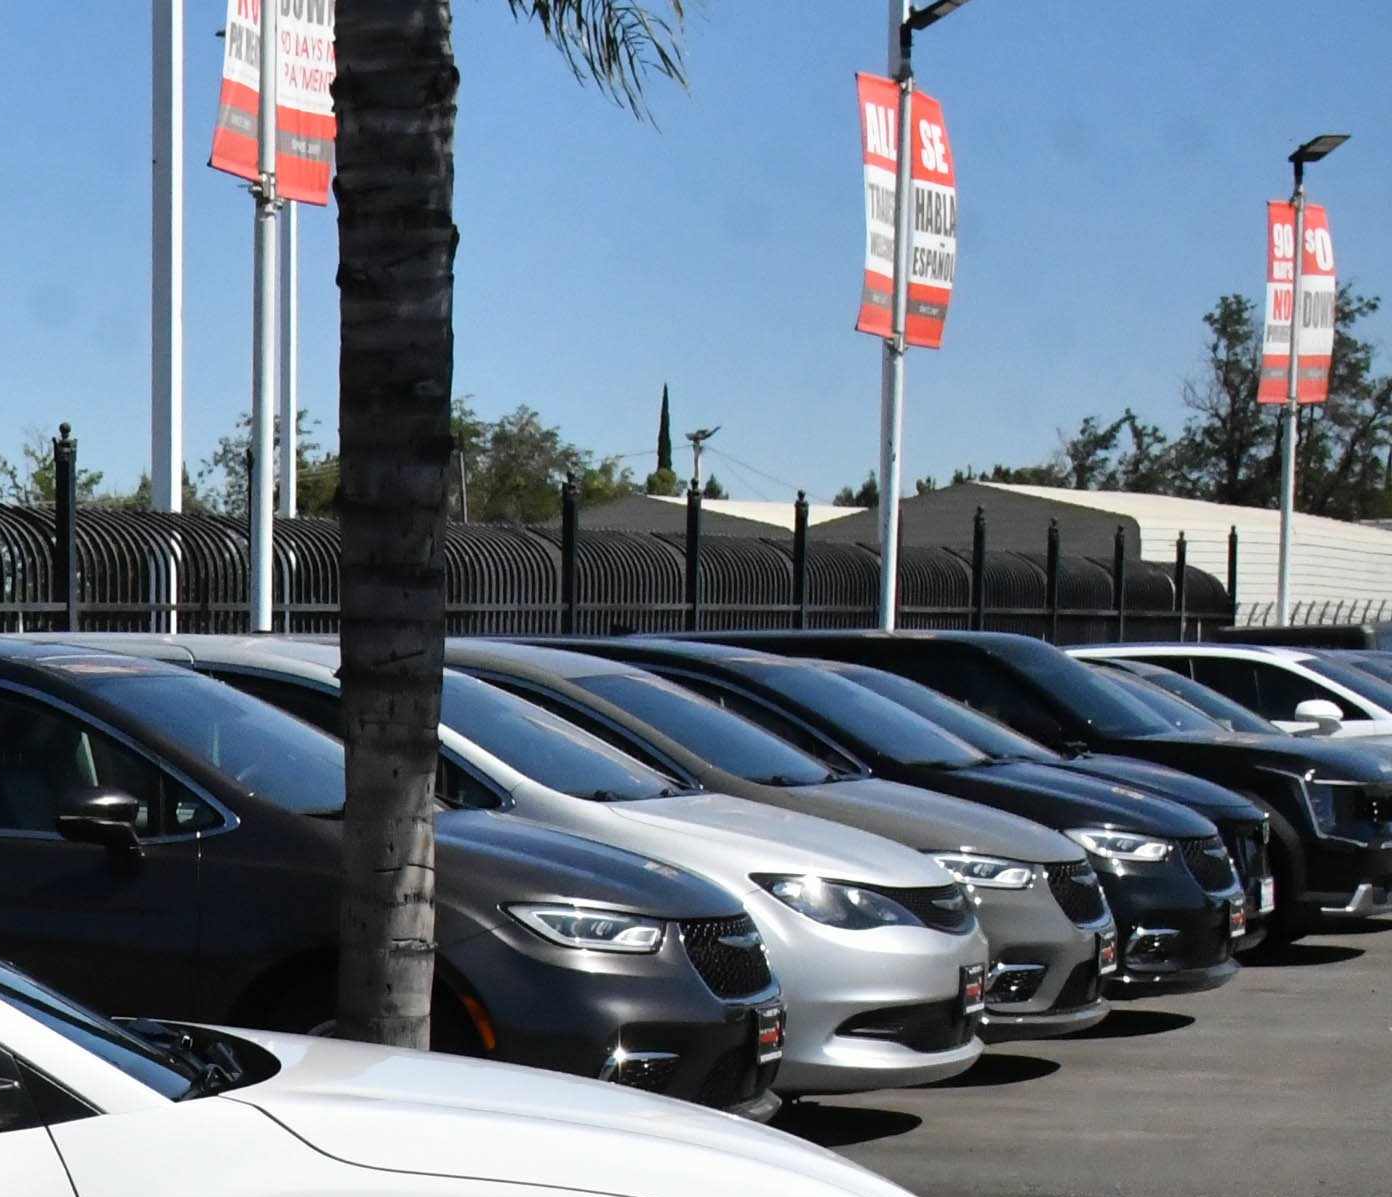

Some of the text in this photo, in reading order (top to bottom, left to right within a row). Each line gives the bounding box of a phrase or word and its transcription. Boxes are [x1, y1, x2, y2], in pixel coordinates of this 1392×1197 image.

[284, 62, 336, 94] AMENT
[865, 102, 897, 161] ALL
[919, 119, 948, 174] SE
[916, 188, 956, 237] HABLA
[1273, 224, 1293, 259] 90
[1305, 228, 1334, 272] $0
[1273, 289, 1292, 321] NO
